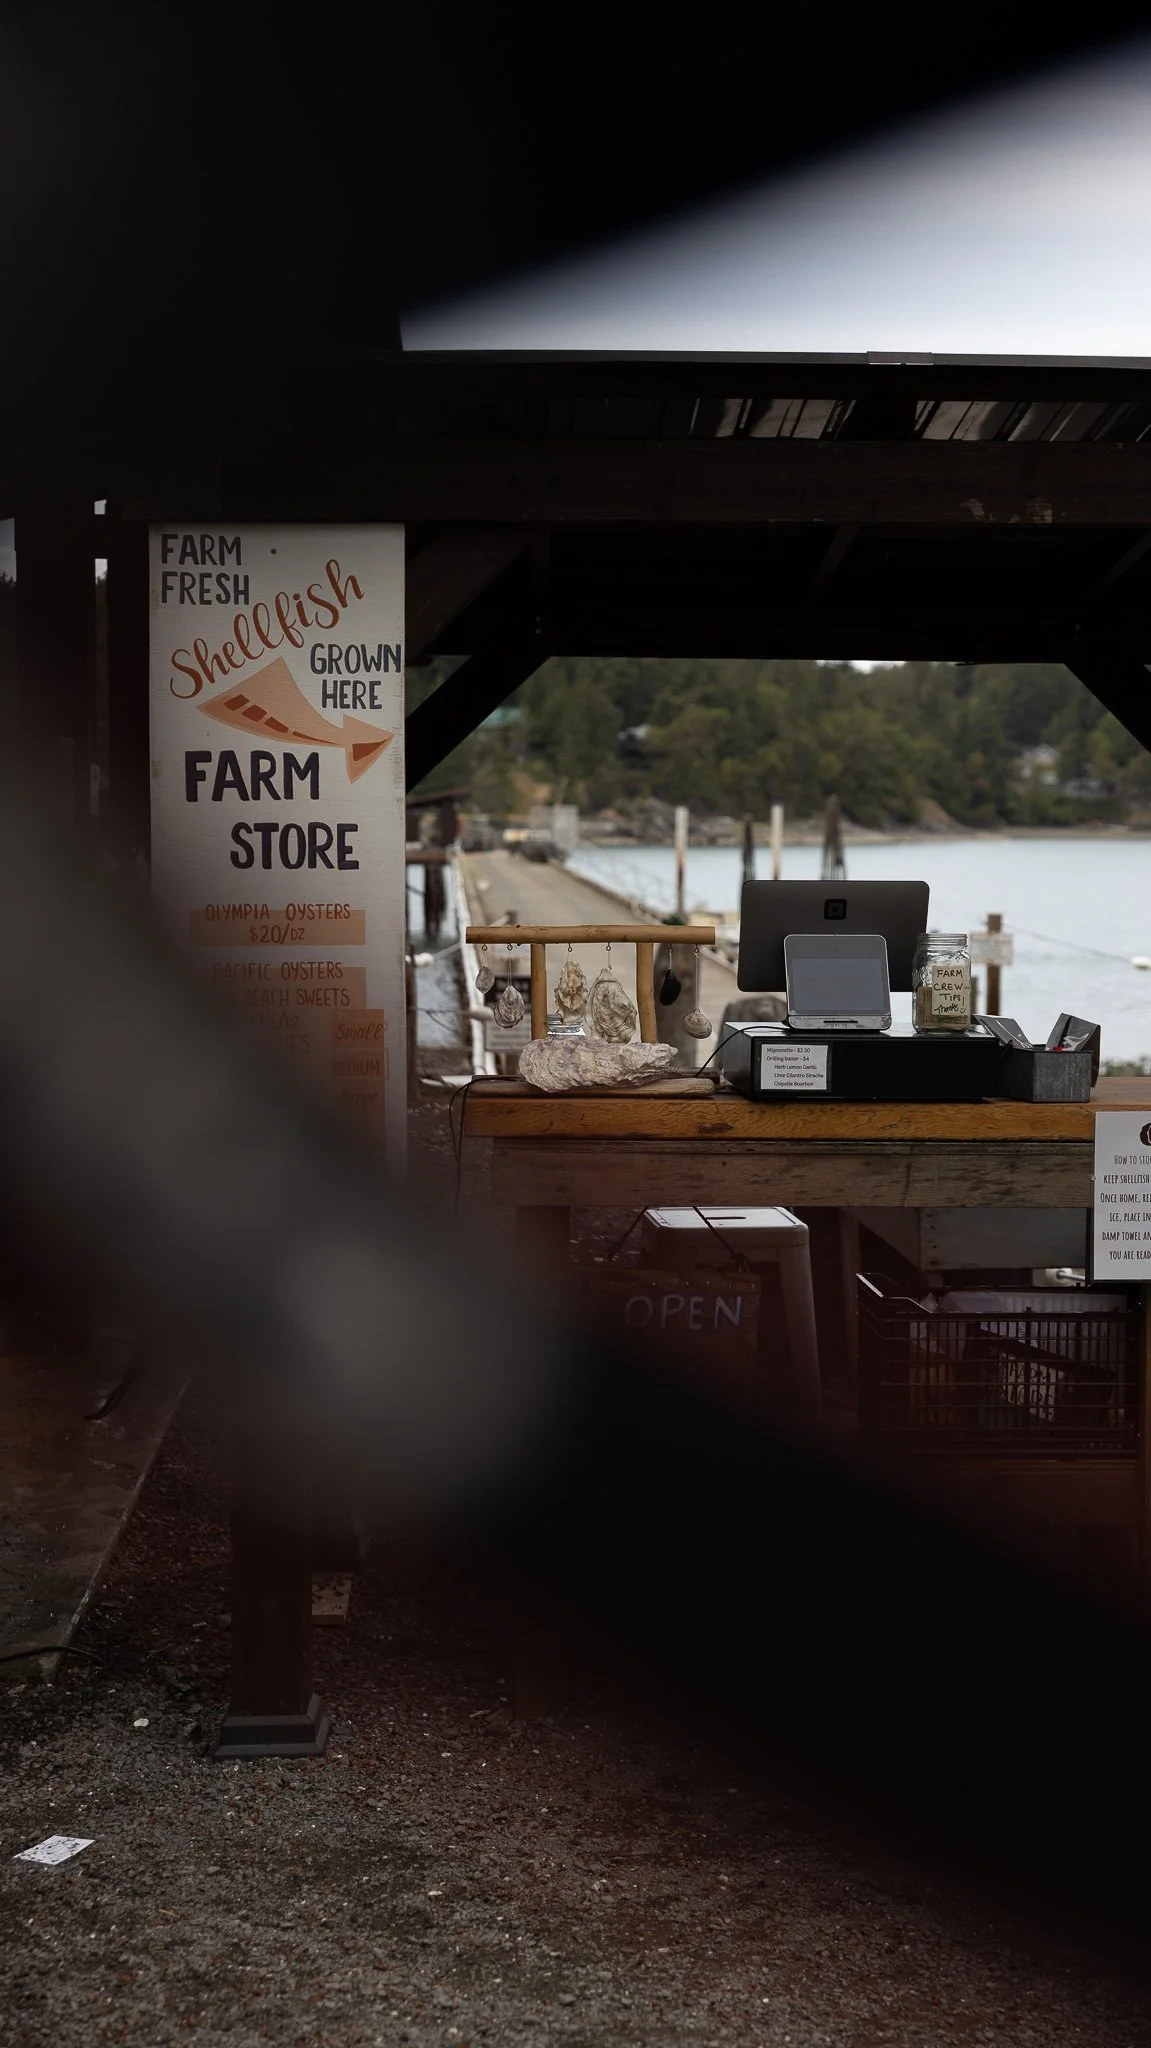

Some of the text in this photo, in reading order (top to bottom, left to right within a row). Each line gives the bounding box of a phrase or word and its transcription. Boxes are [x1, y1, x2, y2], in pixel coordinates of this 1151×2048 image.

[160, 533, 242, 567] FARM
[160, 571, 250, 606] FRESH
[169, 558, 365, 700] Shellfish
[310, 642, 402, 675] GROWN
[321, 679, 382, 710] HERE
[185, 750, 320, 803] FARM
[230, 821, 360, 871] STORE
[205, 903, 351, 921] OLYMPIA OYSTERS
[249, 923, 305, 945] $20/DZ
[214, 961, 344, 982] PACIFIC OYSTERS
[937, 970, 963, 978] FARM
[296, 987, 350, 1007] SWEETS
[934, 983, 963, 991] CREW
[336, 1022, 384, 1041] Small
[1129, 1155, 1138, 1164] TO
[1103, 1174, 1150, 1184] KEEP SHELLFISH
[1123, 1212, 1141, 1222] PLACE
[1102, 1231, 1120, 1241] DAMP
[1122, 1231, 1141, 1241] TOWEL
[1109, 1250, 1122, 1260] YOU
[1123, 1250, 1134, 1260] ARE
[624, 1294, 742, 1330] OPEN
